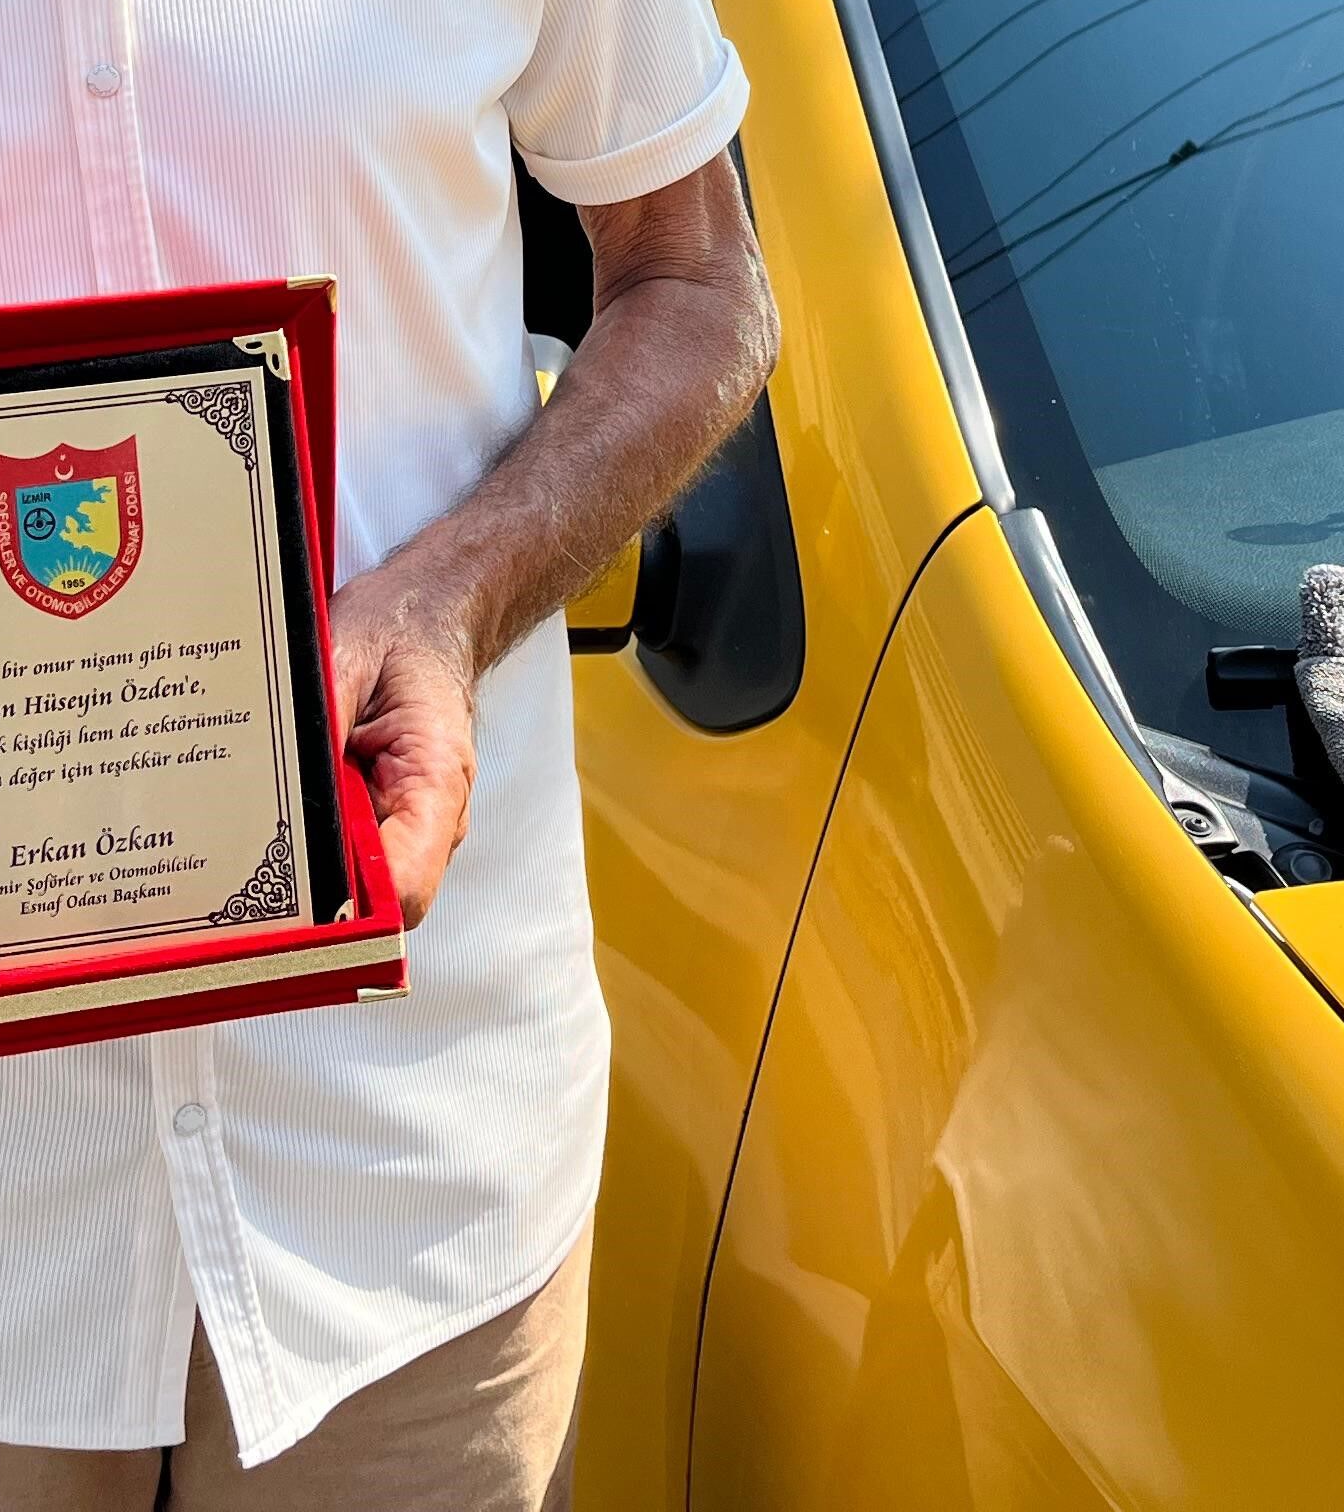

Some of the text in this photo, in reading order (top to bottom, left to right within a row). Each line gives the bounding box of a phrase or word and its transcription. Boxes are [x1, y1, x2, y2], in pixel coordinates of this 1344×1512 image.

[11, 569, 29, 589] VE
[25, 566, 128, 614] OTOMOBİLCİLER
[123, 521, 140, 566] ESNAF
[61, 579, 86, 590] 1965
[2, 661, 28, 680] bir
[33, 659, 75, 676] onur
[81, 652, 134, 672] nişanı
[139, 642, 172, 670] gibi
[178, 639, 241, 661] taşıyan
[23, 688, 113, 718] Hüseyin
[121, 675, 206, 703] Özden'e,
[13, 729, 71, 755] kişiliği
[78, 725, 114, 744] hem
[119, 719, 139, 739] de
[144, 709, 251, 736] sektörümüze
[9, 767, 55, 792] değer
[61, 761, 93, 783] için
[99, 750, 172, 778] teşekkür
[177, 743, 232, 765] ederiz.
[10, 825, 174, 868] Erkan Özkan
[27, 869, 84, 896] Şoförler
[89, 872, 104, 883] ve
[109, 854, 208, 881] Otomobilciler
[20, 883, 171, 917] Esnaf Odası Başkanı
